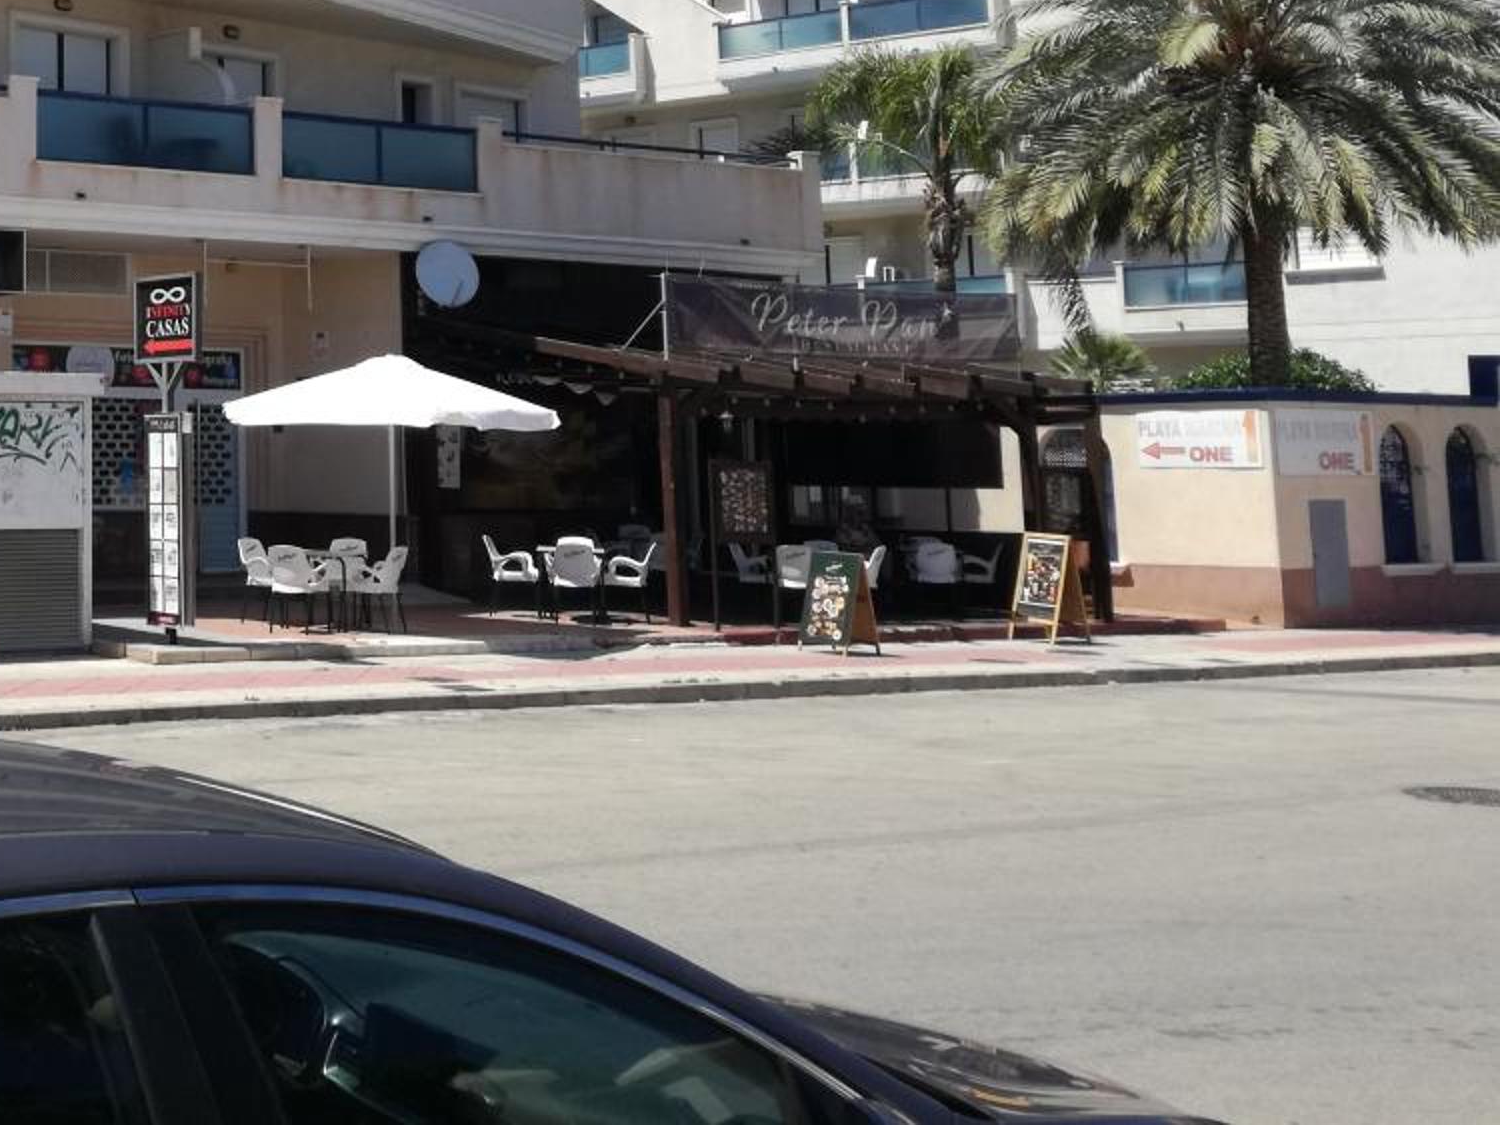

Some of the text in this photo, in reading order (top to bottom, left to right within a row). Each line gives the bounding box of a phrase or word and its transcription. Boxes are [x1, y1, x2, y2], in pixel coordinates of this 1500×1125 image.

[751, 292, 848, 335] Peter
[145, 317, 190, 338] CASAS
[1189, 445, 1235, 463] ONE
